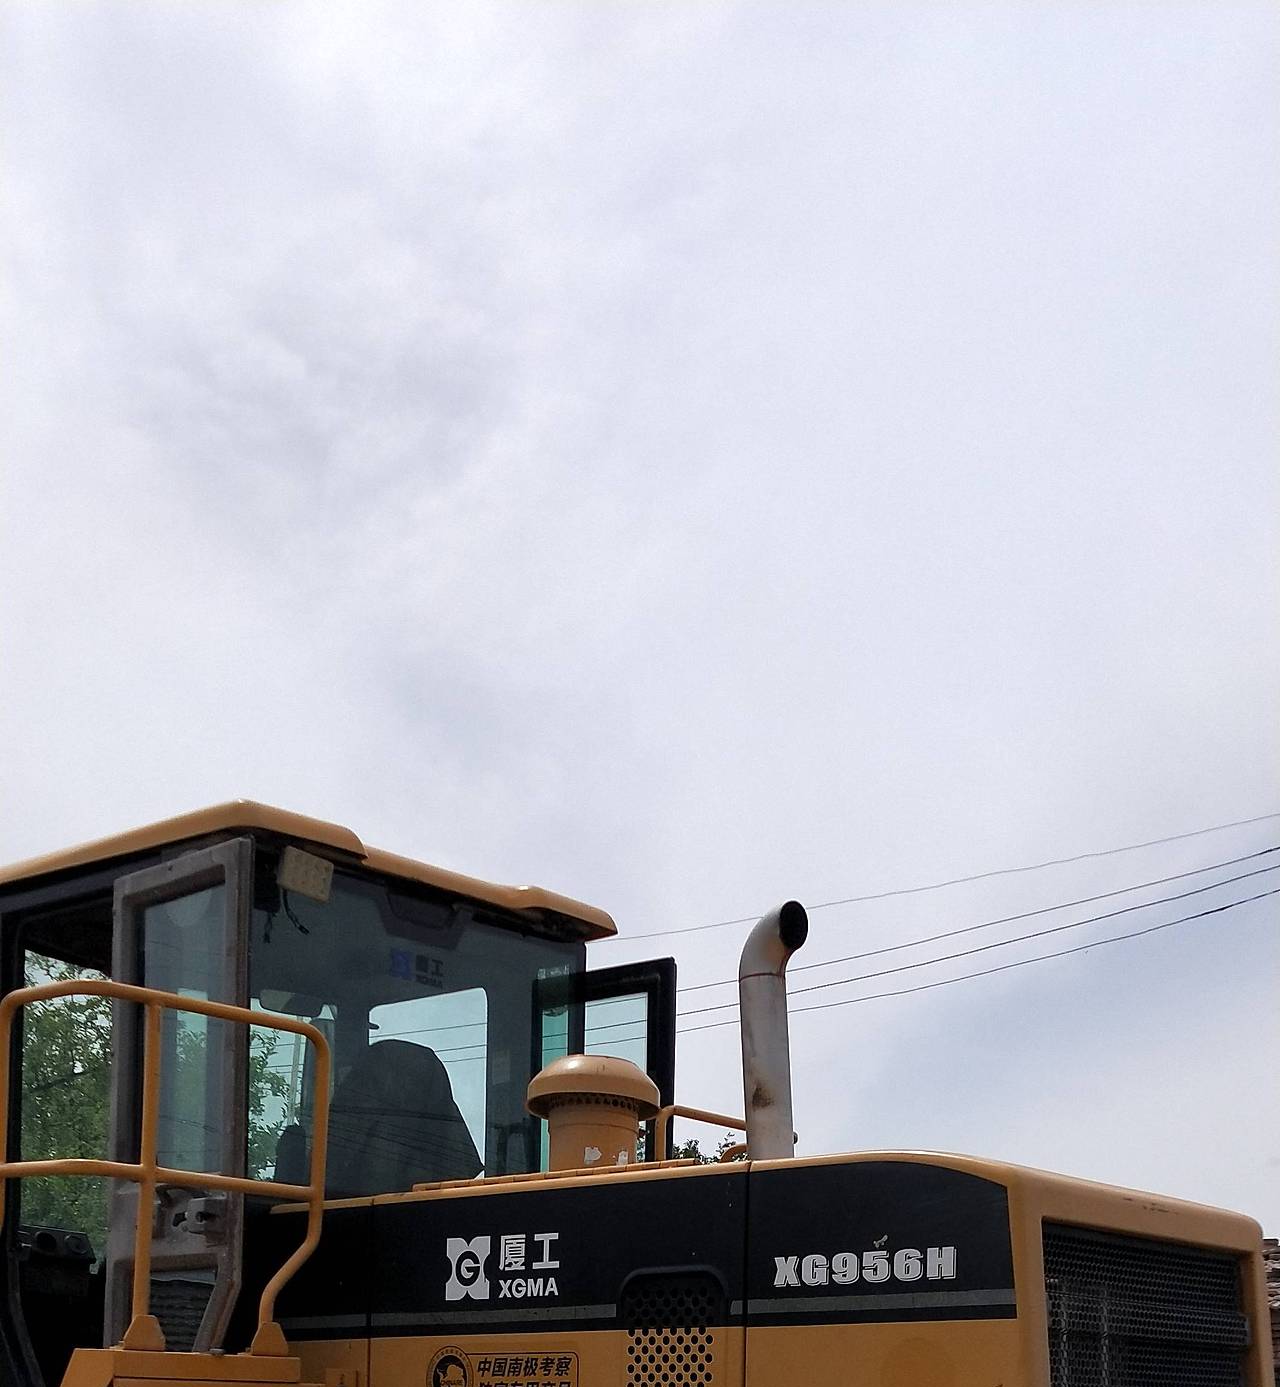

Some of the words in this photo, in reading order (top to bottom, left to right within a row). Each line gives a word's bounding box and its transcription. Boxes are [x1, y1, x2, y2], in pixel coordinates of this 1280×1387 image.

[499, 1232, 560, 1271] 厦工
[773, 1246, 956, 1287] XG956H
[499, 1277, 559, 1298] XGMA
[477, 1357, 572, 1377] 中国南极考察
